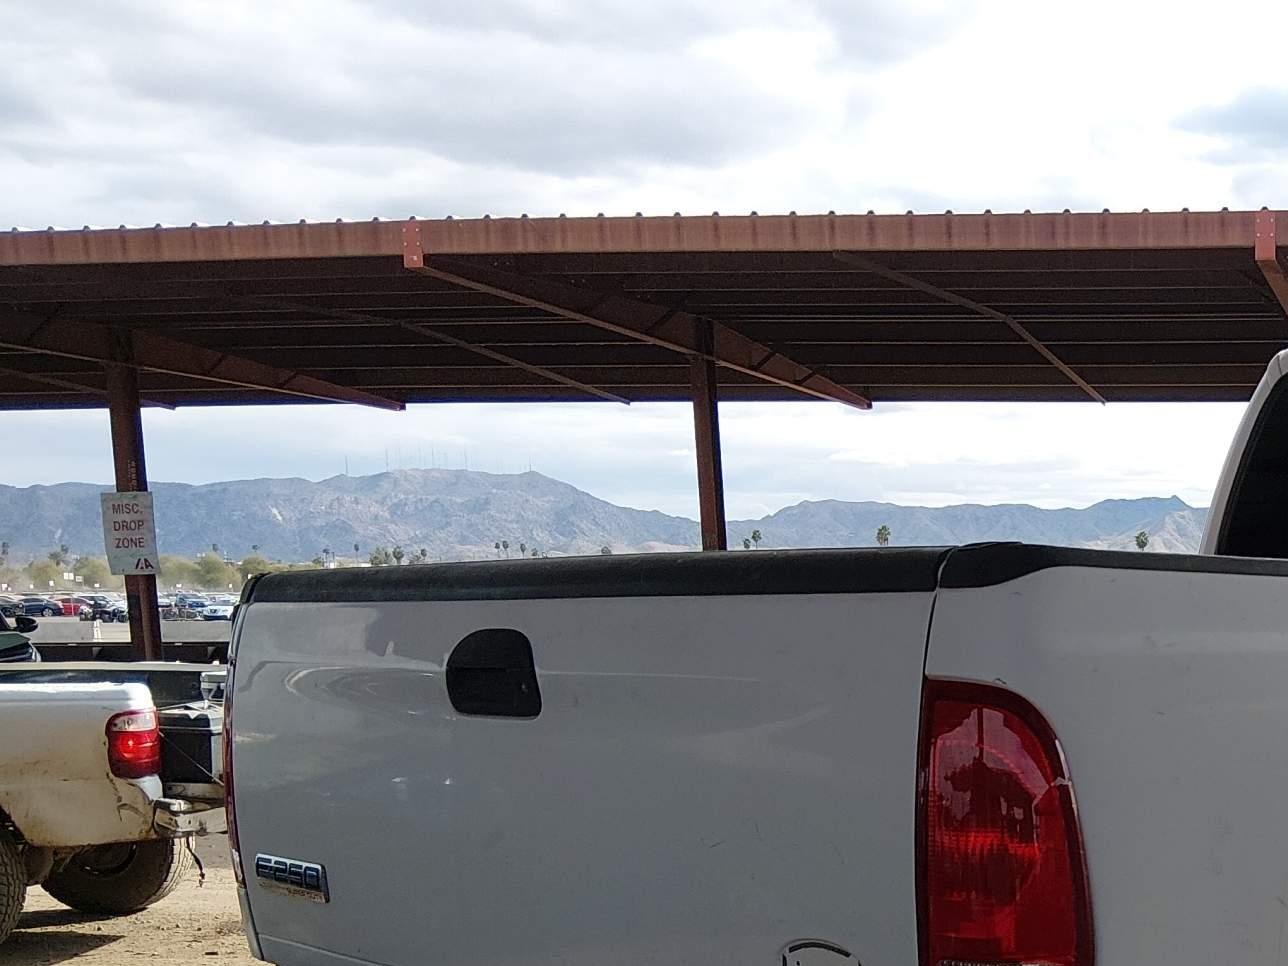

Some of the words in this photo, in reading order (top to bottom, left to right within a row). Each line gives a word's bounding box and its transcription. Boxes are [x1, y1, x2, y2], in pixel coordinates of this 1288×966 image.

[112, 503, 143, 514] MISC.
[113, 520, 144, 532] DROP
[115, 537, 145, 549] ZONE
